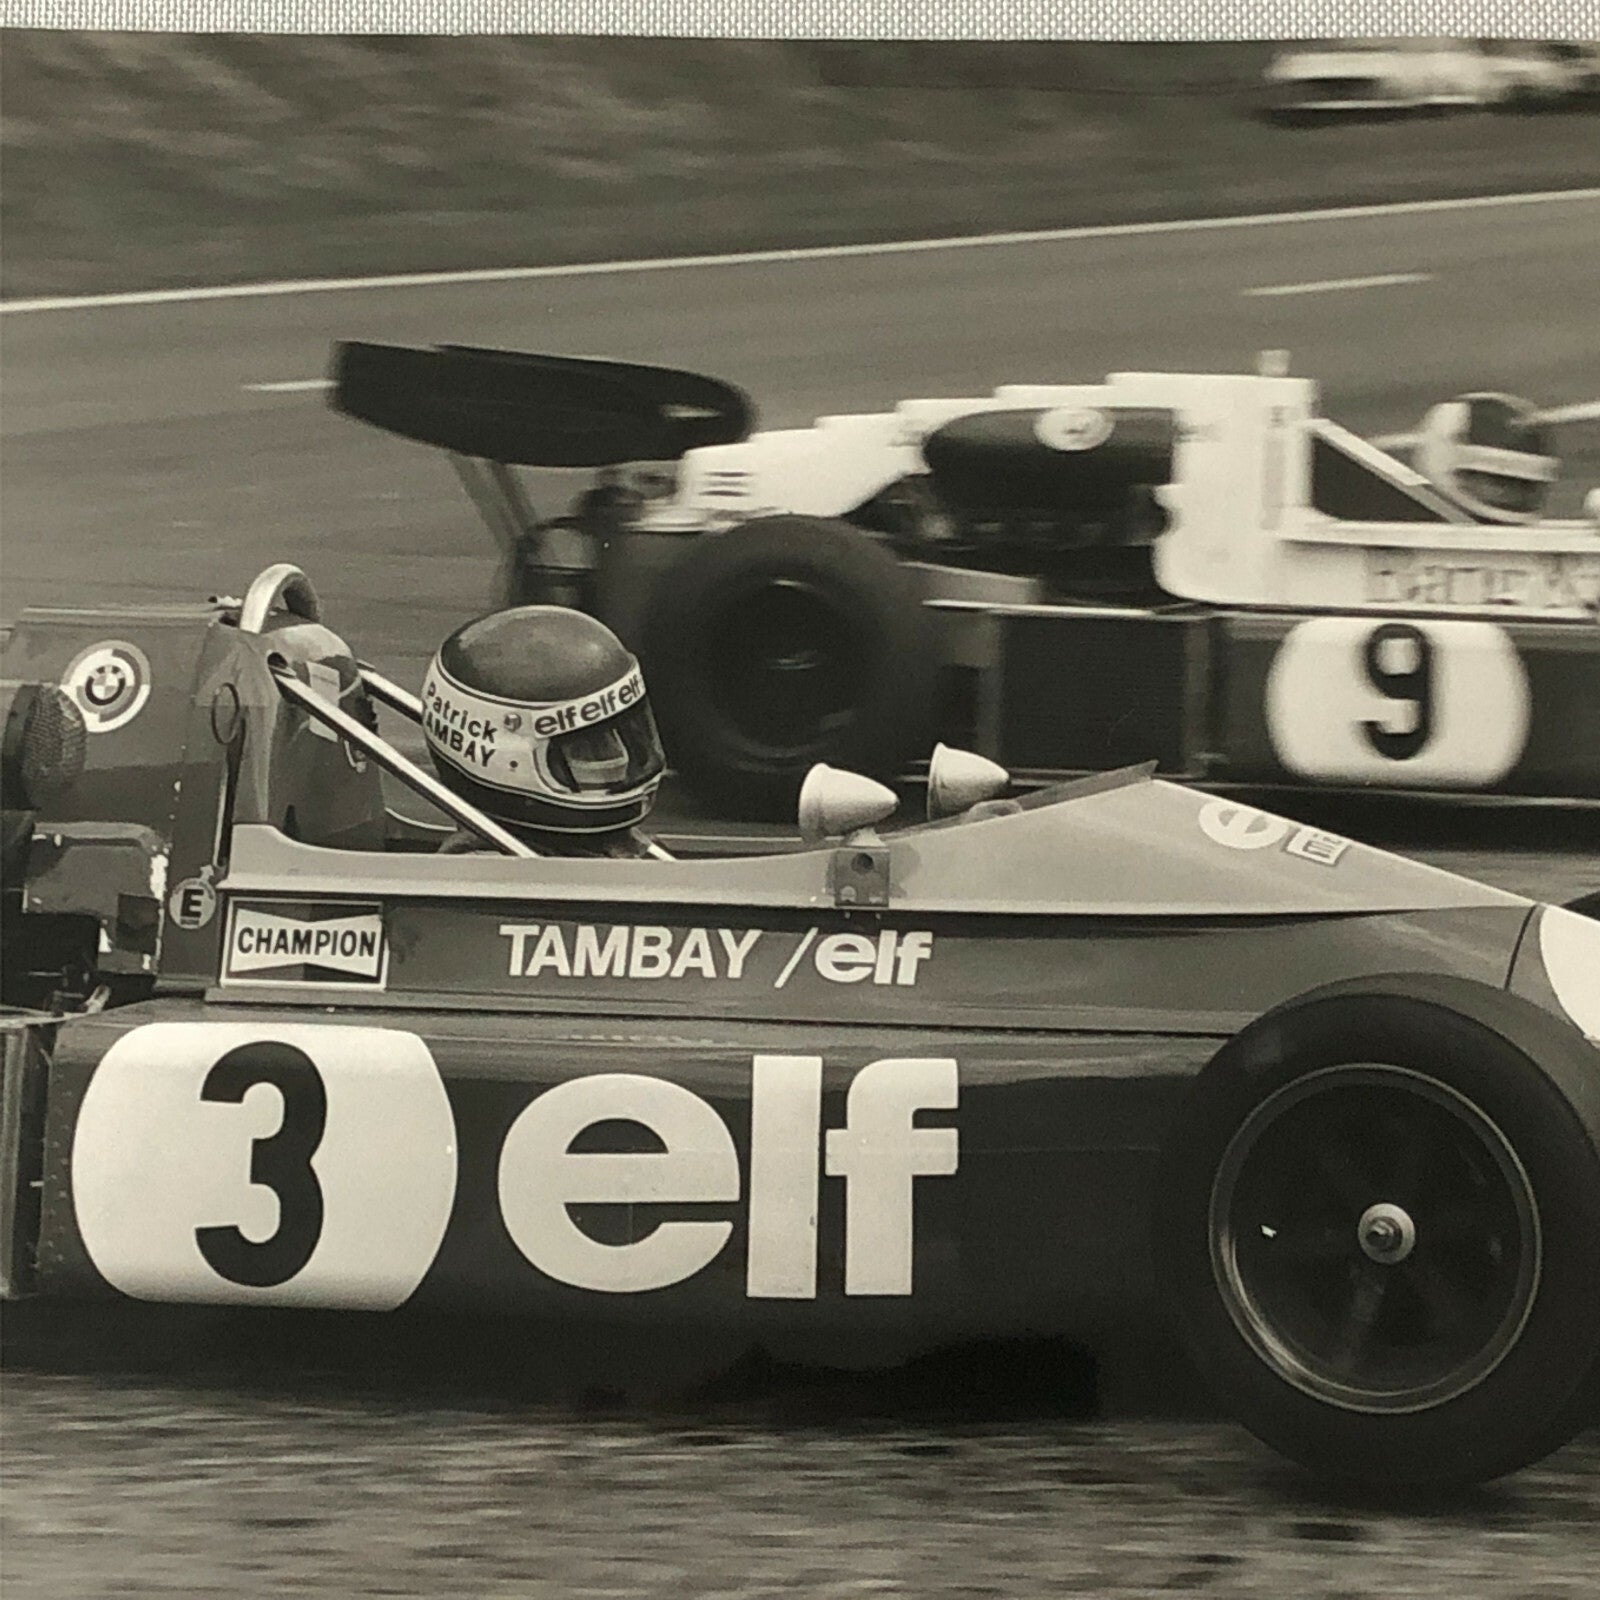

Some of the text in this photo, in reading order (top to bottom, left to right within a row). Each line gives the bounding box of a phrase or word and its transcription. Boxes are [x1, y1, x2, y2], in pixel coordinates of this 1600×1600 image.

[427, 681, 498, 743] Patrick
[1362, 623, 1434, 760] 9
[424, 711, 497, 767] AMBAY
[237, 926, 377, 957] CHAMPION
[499, 924, 763, 979] TAMBAY
[195, 1040, 959, 1299] 3 elf
